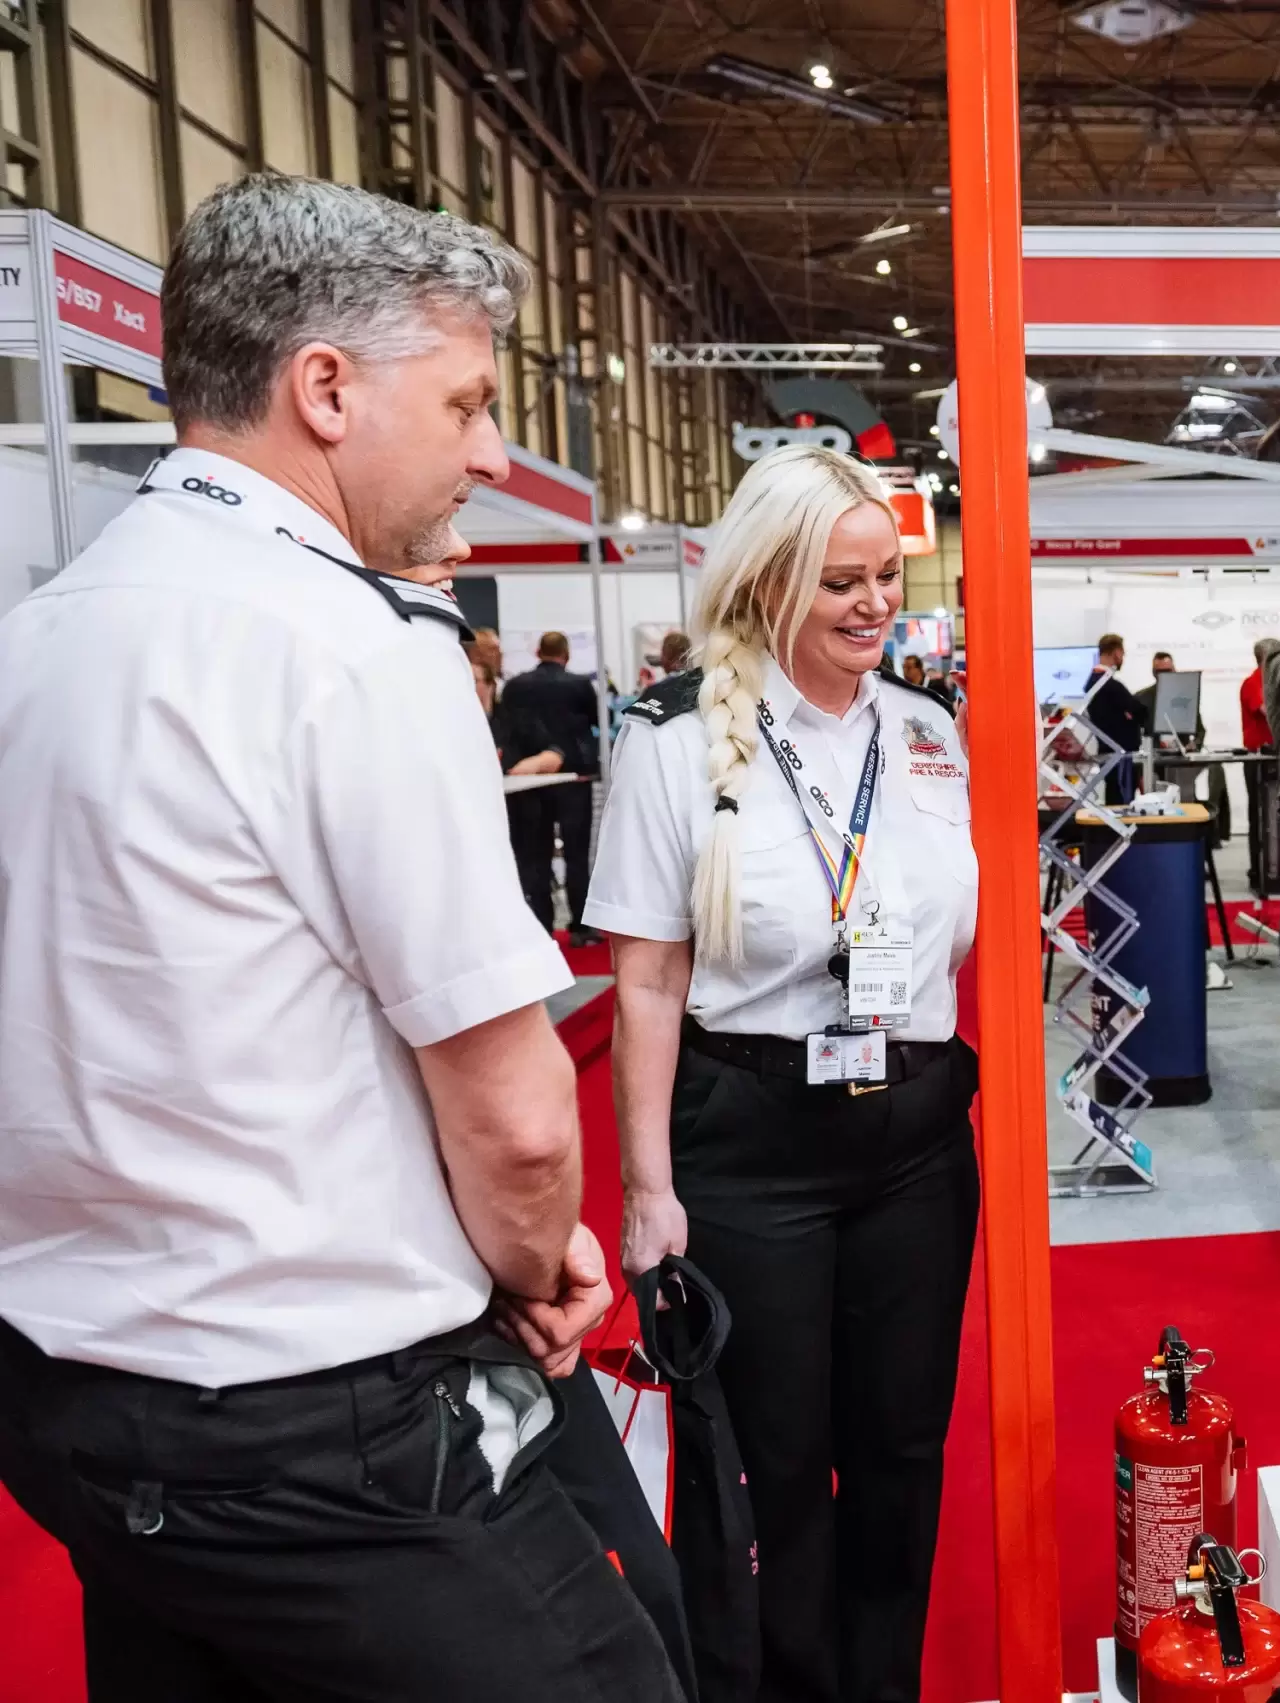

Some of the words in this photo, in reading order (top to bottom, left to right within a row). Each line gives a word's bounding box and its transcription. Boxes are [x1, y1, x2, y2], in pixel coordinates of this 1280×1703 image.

[182, 475, 242, 506] aico
[780, 739, 803, 770] aico
[864, 751, 876, 786] RESCUE
[911, 762, 958, 771] DERBYSHIRE
[935, 769, 965, 778] RESCUE
[810, 786, 834, 818] aico
[855, 786, 870, 826] SERVICE
